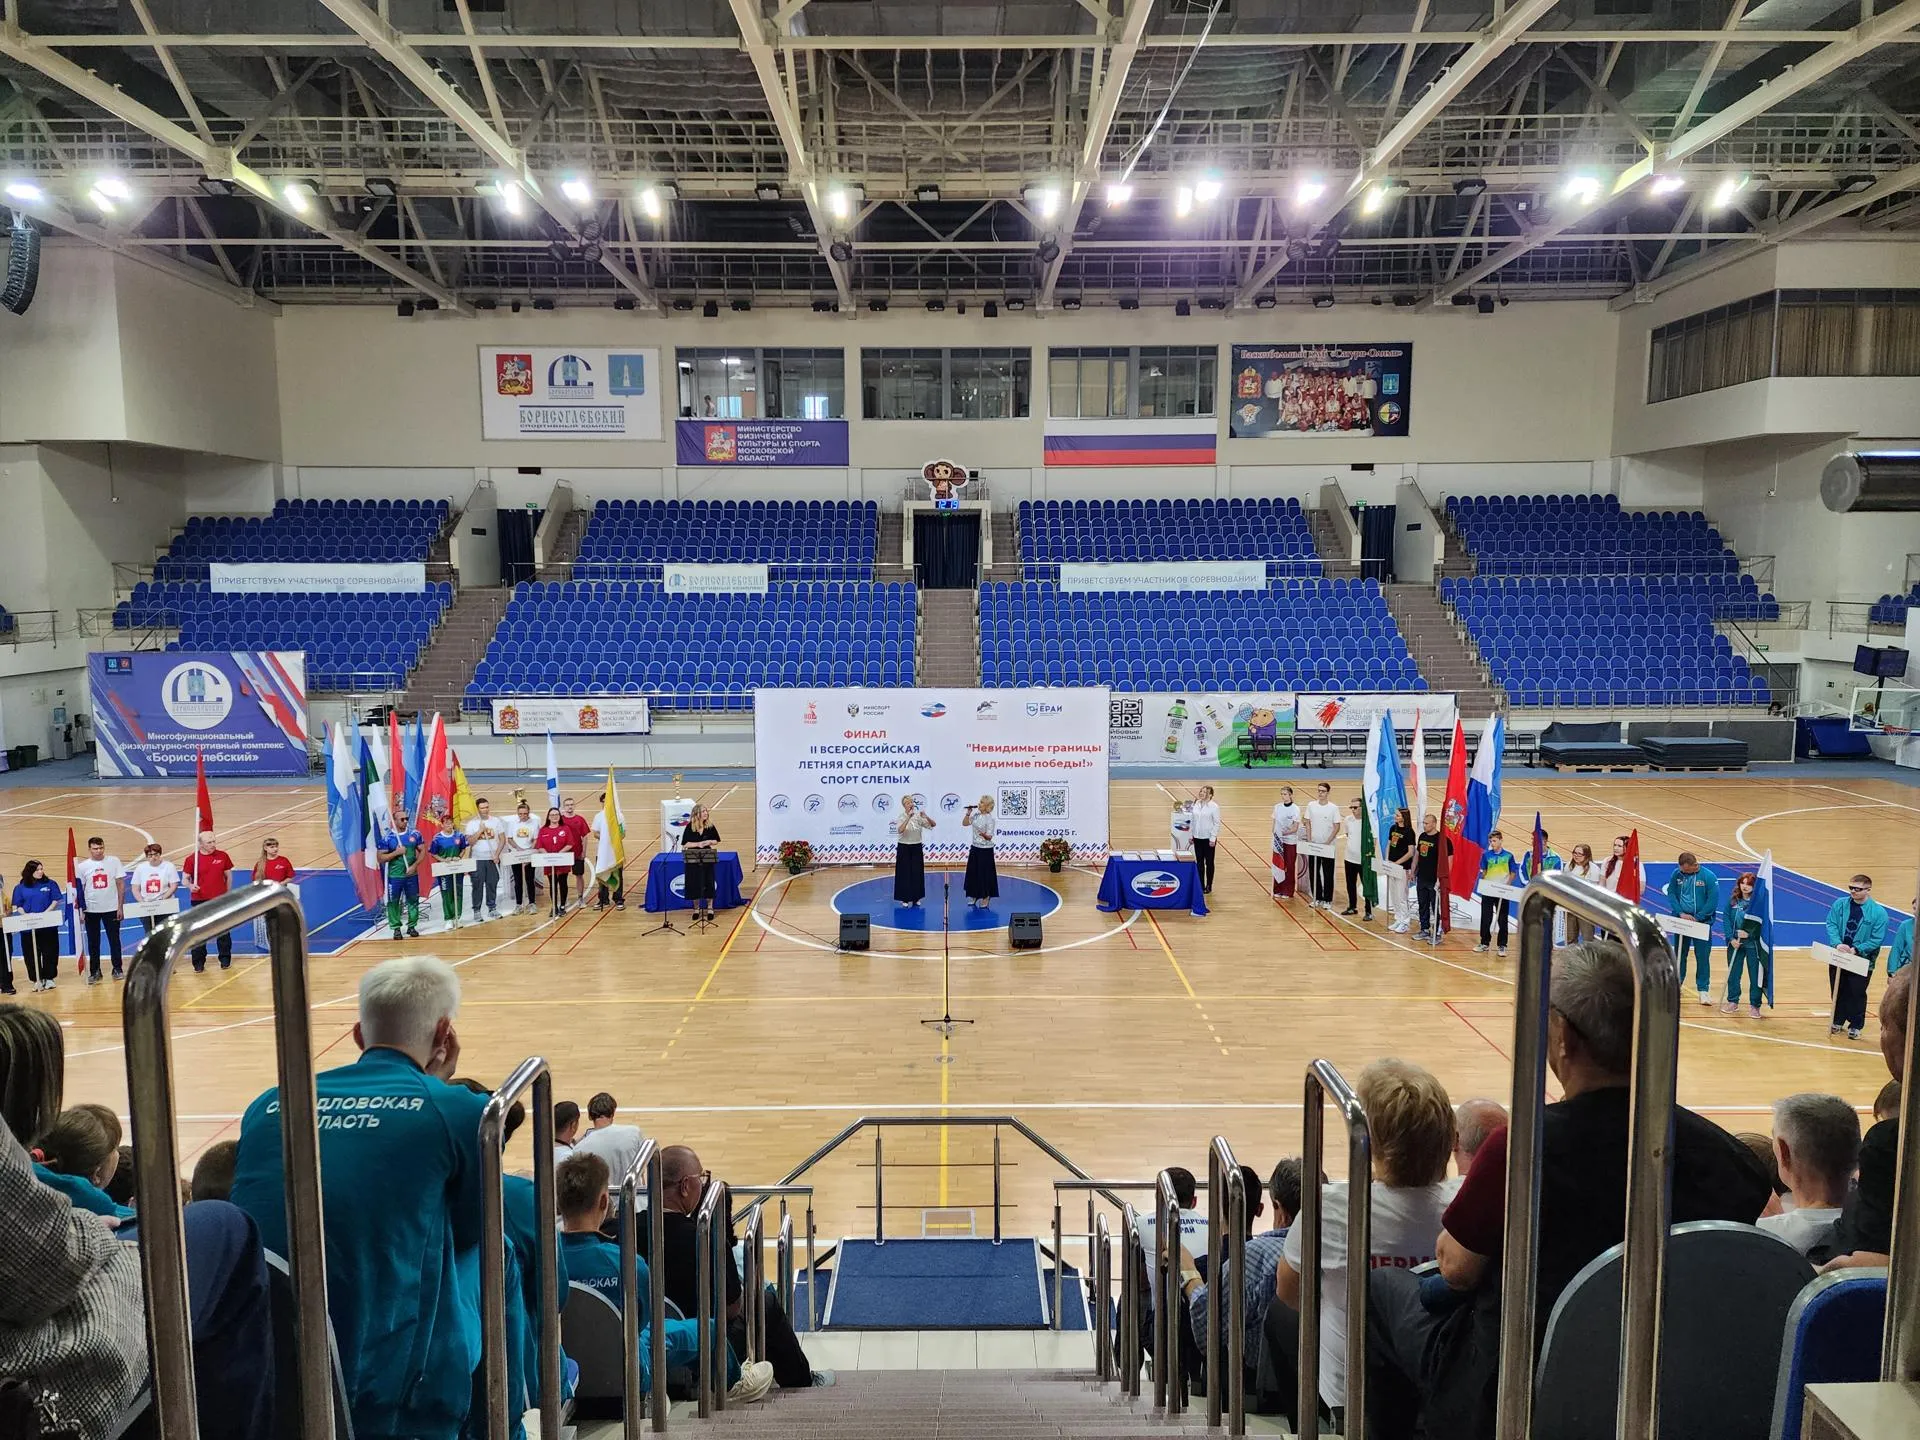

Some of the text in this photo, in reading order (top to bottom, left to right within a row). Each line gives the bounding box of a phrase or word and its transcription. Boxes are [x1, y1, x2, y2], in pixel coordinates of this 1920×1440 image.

[217, 577, 285, 585] ПРИВЕТСТВУЕМ
[288, 577, 345, 585] УЧАСТНИКОВ
[1133, 576, 1188, 584] УЧАСТНИКОВ
[147, 732, 254, 743] Многофункциональный
[843, 729, 887, 739] ФИНАЛ
[820, 743, 920, 754] ВСЕРОССИЙСКАЯ
[966, 744, 1102, 755] "Невидимые границы
[146, 752, 259, 763] «Борисолебский»
[798, 761, 932, 770] ЛЕТНЯЯ СПАРТАКИАДА
[974, 759, 1093, 769] видимые победы!»
[820, 776, 910, 784] СПОРТ СЛЕПЫХ
[266, 1096, 425, 1115] СДЛОВСКАЯ
